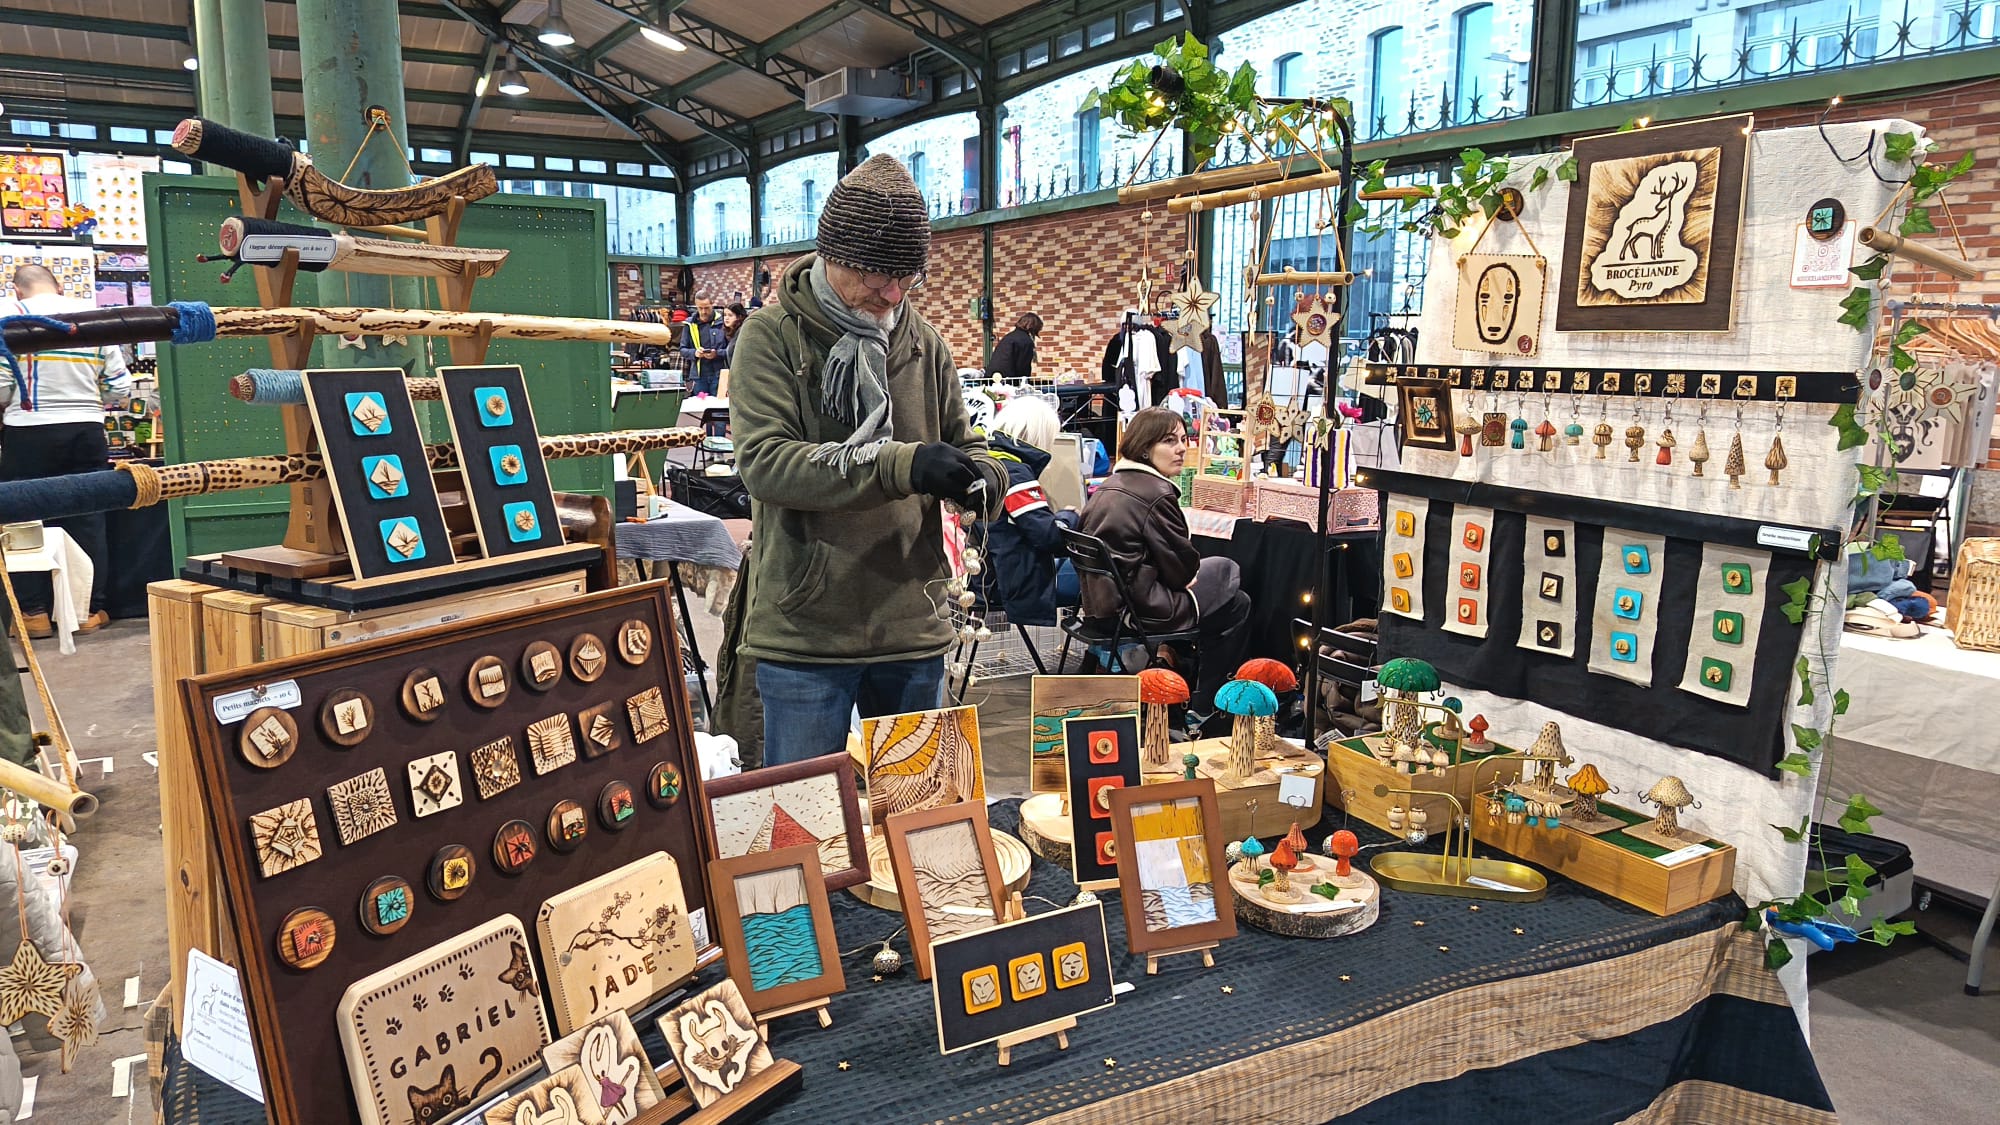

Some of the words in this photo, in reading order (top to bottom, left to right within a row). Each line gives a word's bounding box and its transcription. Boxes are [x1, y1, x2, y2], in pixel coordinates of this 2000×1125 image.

[1628, 280, 1654, 292] Pyro
[222, 702, 242, 712] Petits
[243, 696, 271, 707] magnets
[589, 952, 658, 1015] JADE
